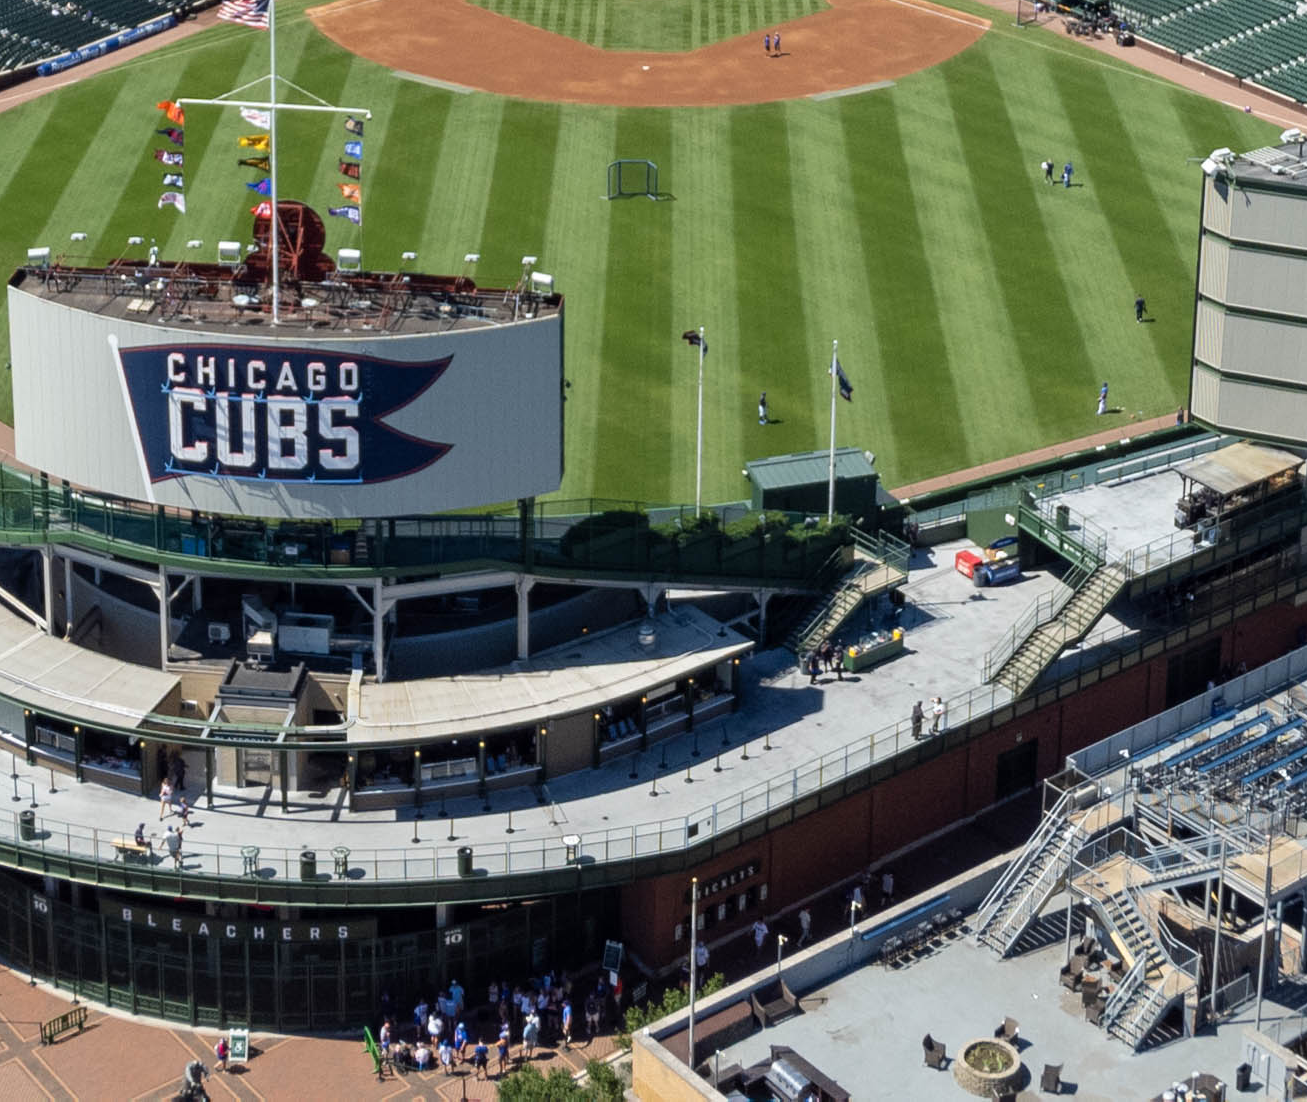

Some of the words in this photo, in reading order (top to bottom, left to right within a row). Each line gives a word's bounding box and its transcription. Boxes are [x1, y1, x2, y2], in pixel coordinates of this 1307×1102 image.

[167, 352, 359, 391] CHICAGO
[168, 387, 360, 470] CUBS
[34, 900, 48, 913] 10
[123, 908, 349, 940] BLEACHERS
[445, 934, 463, 945] 10
